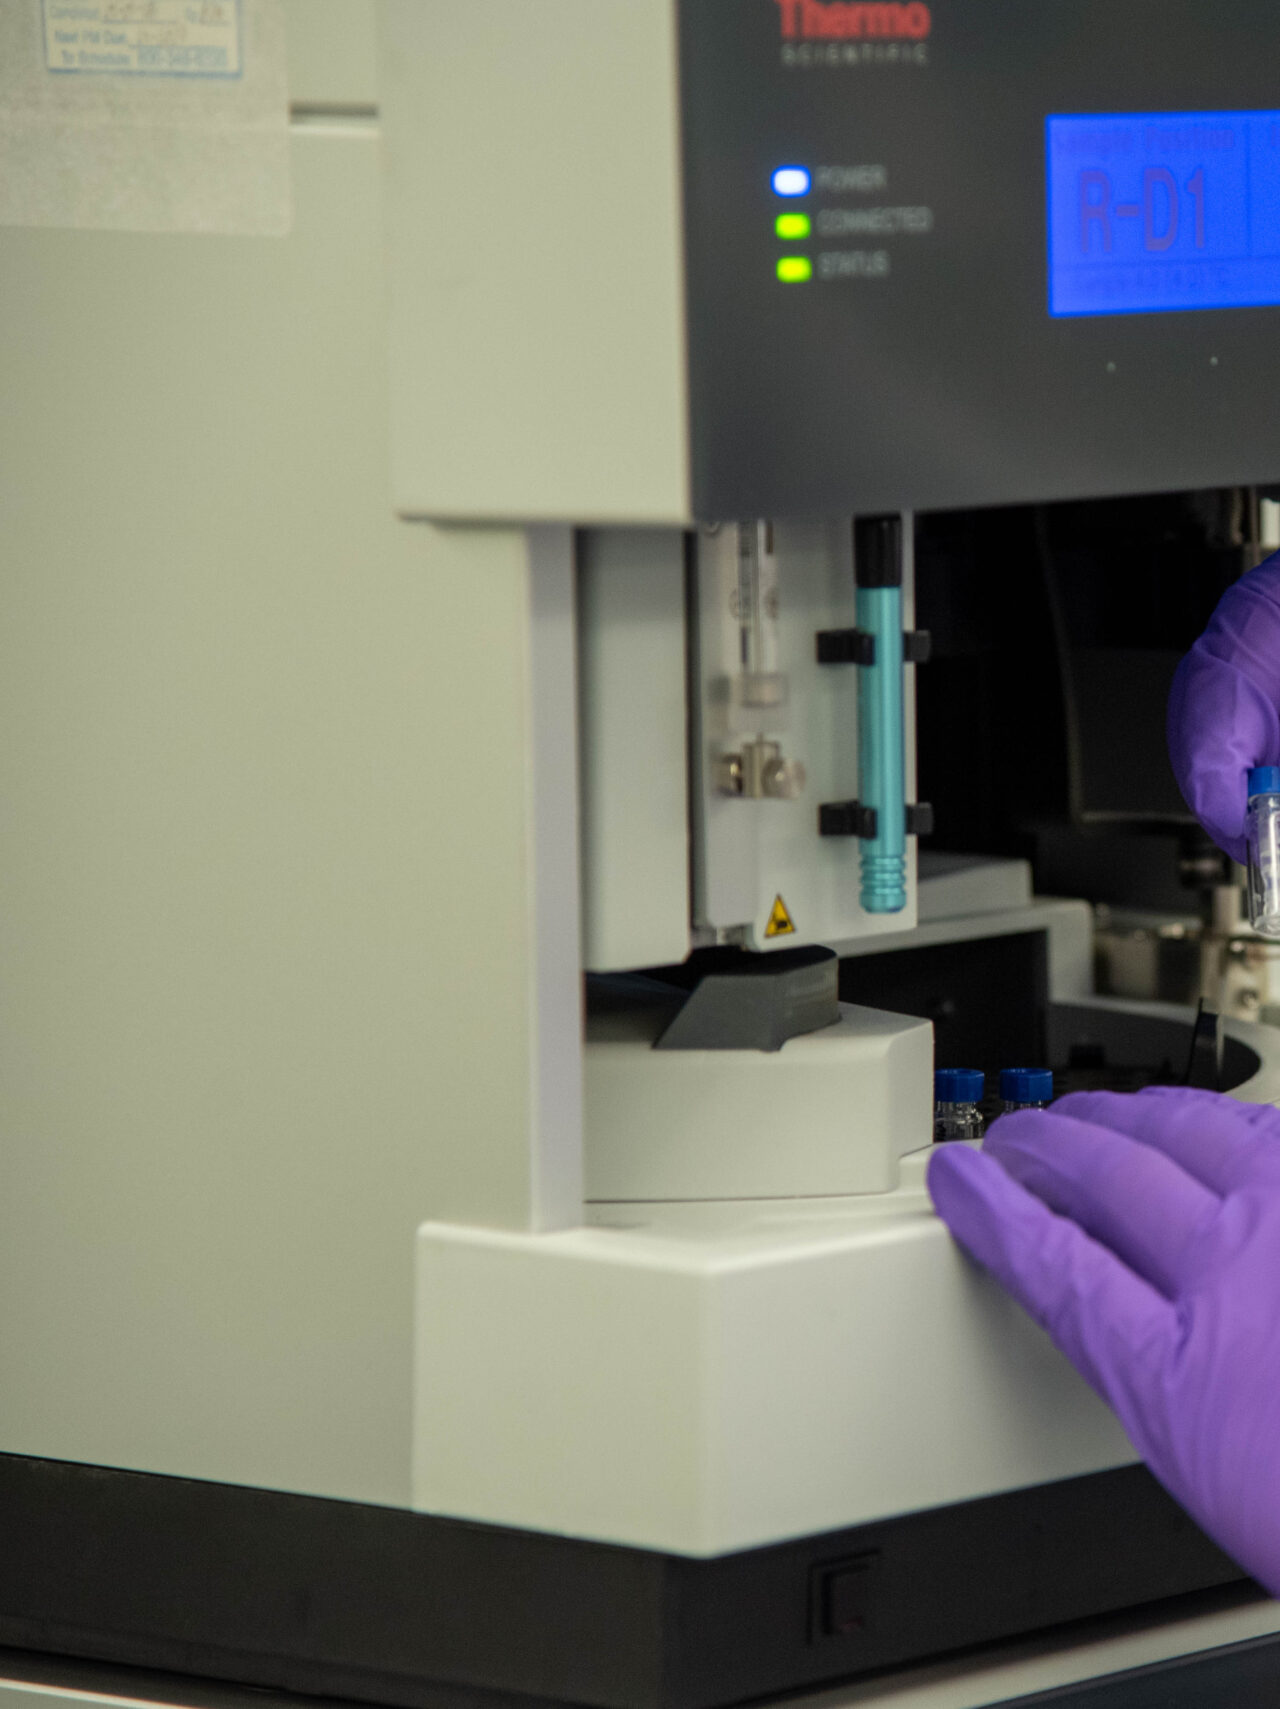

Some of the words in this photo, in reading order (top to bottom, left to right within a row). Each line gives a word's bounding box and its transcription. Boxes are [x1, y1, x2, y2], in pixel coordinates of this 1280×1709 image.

[776, 0, 932, 39] Thermo
[781, 43, 929, 66] SCIENTIFIC
[1078, 163, 1206, 254] R-D1
